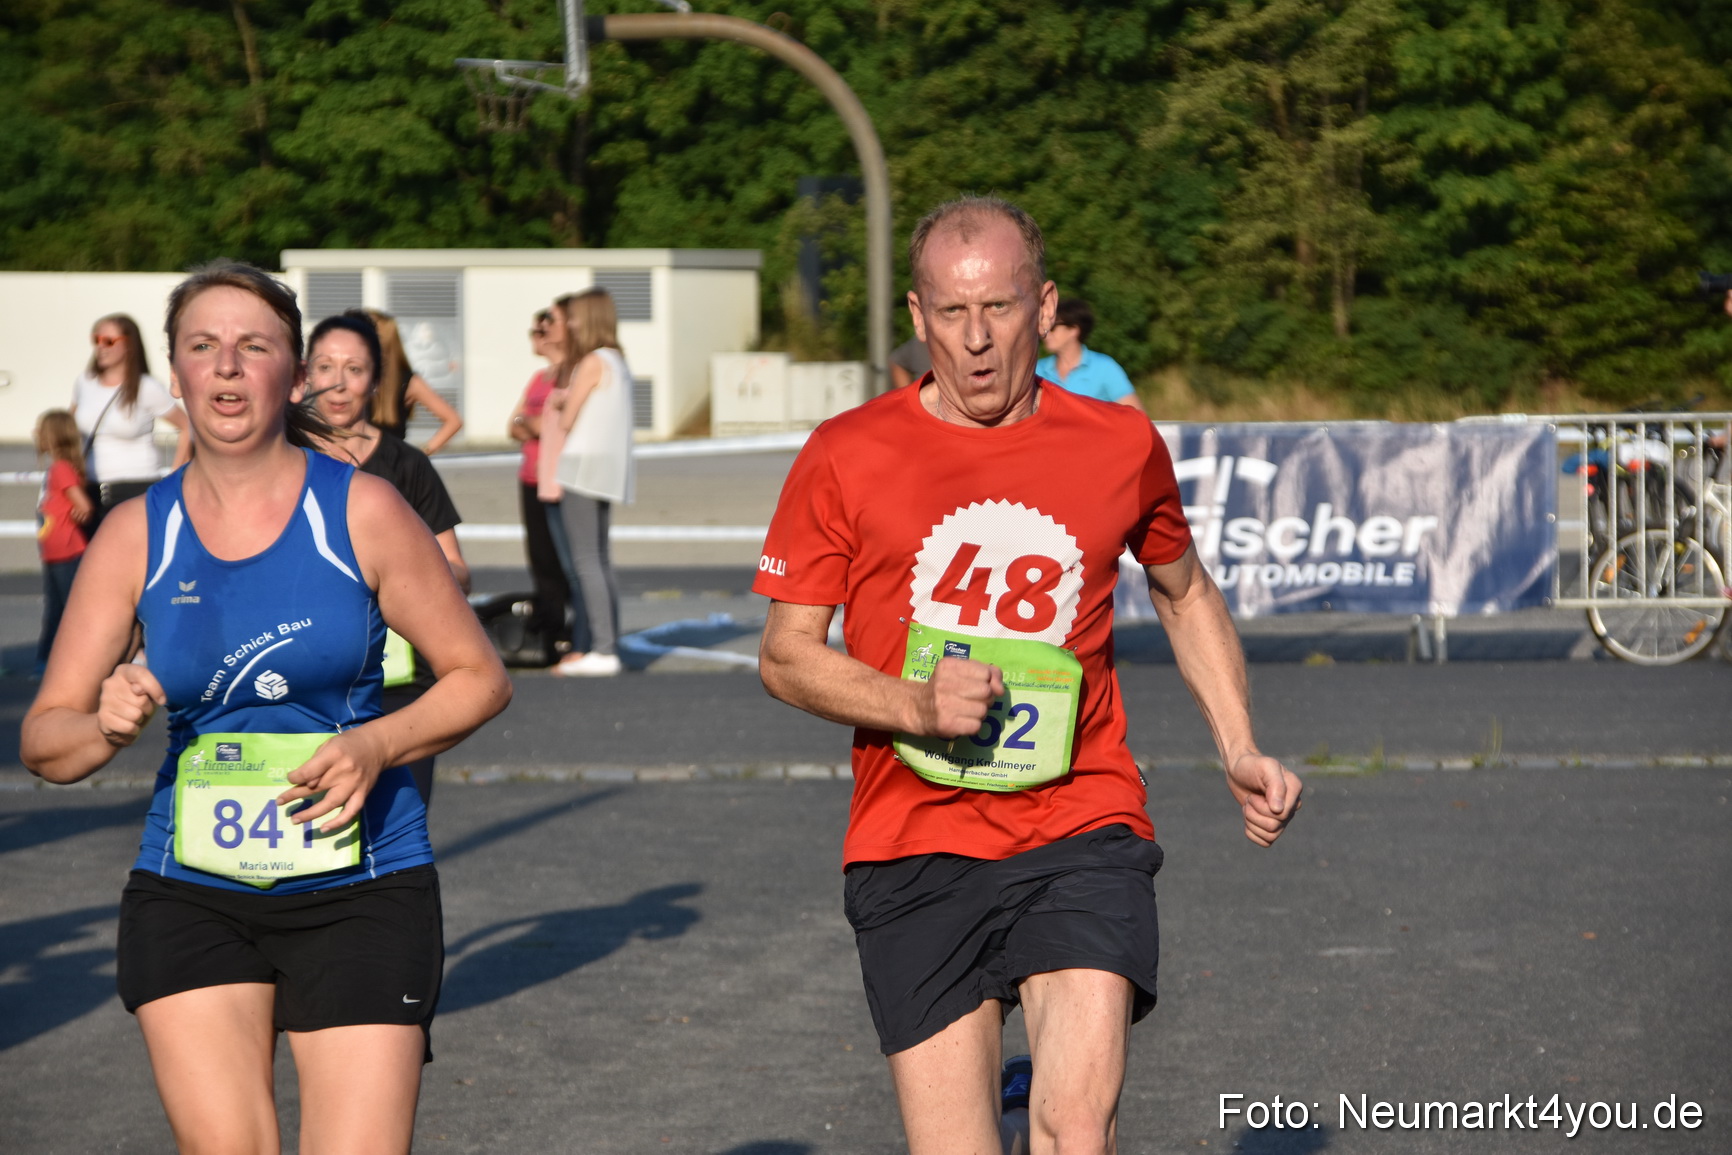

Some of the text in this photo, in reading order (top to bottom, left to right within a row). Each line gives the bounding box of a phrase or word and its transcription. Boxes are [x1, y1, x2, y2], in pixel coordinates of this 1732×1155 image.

[931, 541, 1064, 633] 48
[1203, 562, 1416, 588] UTOMOBILE
[170, 594, 201, 605] erima
[201, 617, 312, 702] Team Schick Bau
[204, 760, 266, 772] firmenlauf
[924, 749, 1037, 772] Wolfgang Knollmeyer
[213, 799, 313, 850] 841
[239, 861, 294, 871] Maria Wild
